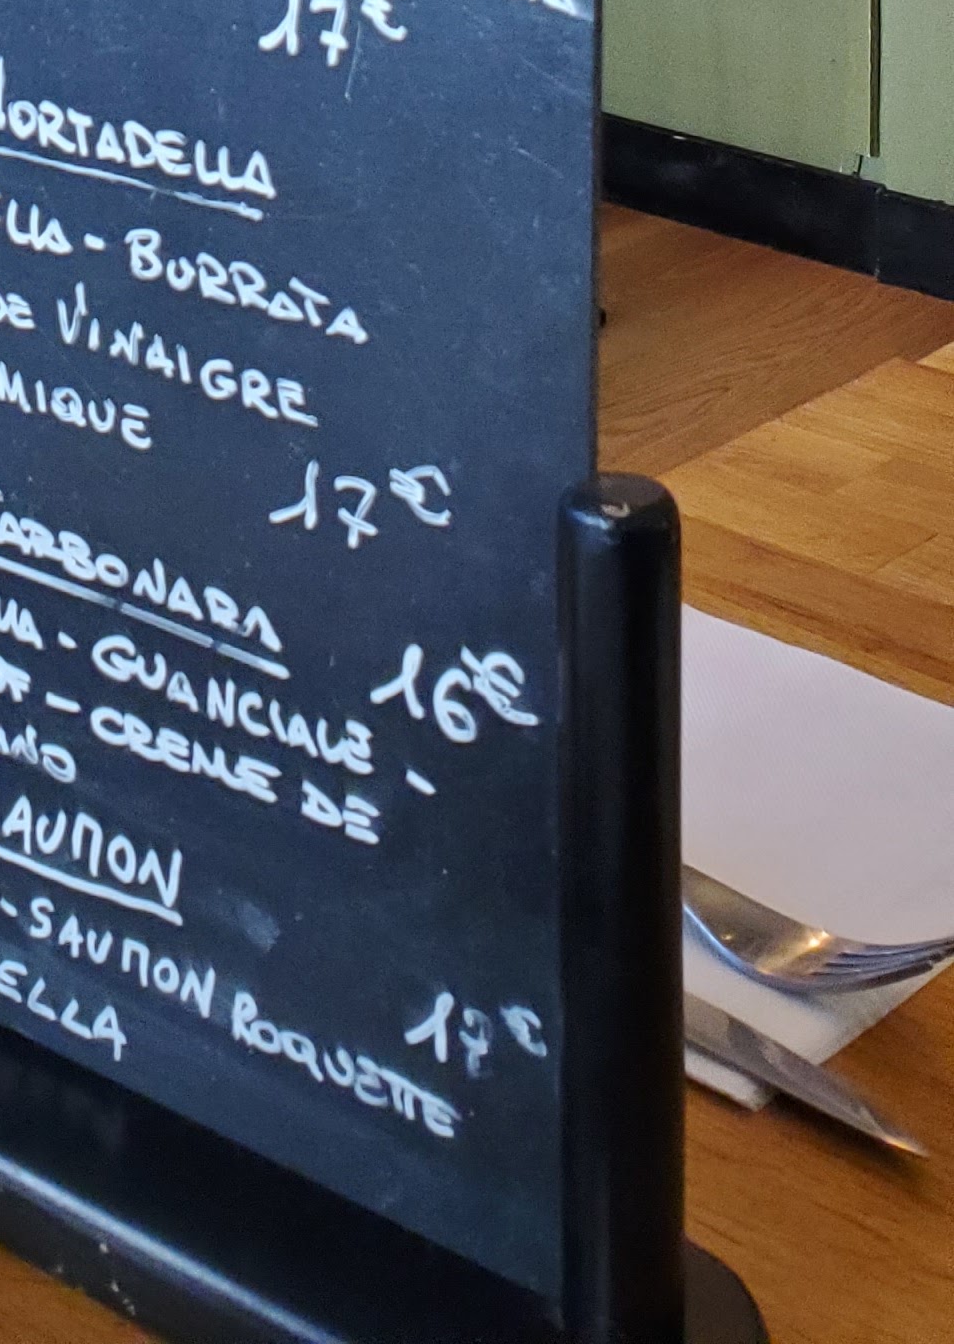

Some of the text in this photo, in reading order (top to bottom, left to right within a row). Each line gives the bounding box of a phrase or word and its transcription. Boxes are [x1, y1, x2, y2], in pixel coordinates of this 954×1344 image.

[56, 282, 318, 428] VINAIGRE
[124, 229, 368, 344] BURRATA
[92, 636, 374, 775] GUANCIALE
[301, 777, 379, 847] DE
[28, 896, 214, 1019] SAUMON
[231, 991, 460, 1139] ROQUETTE
